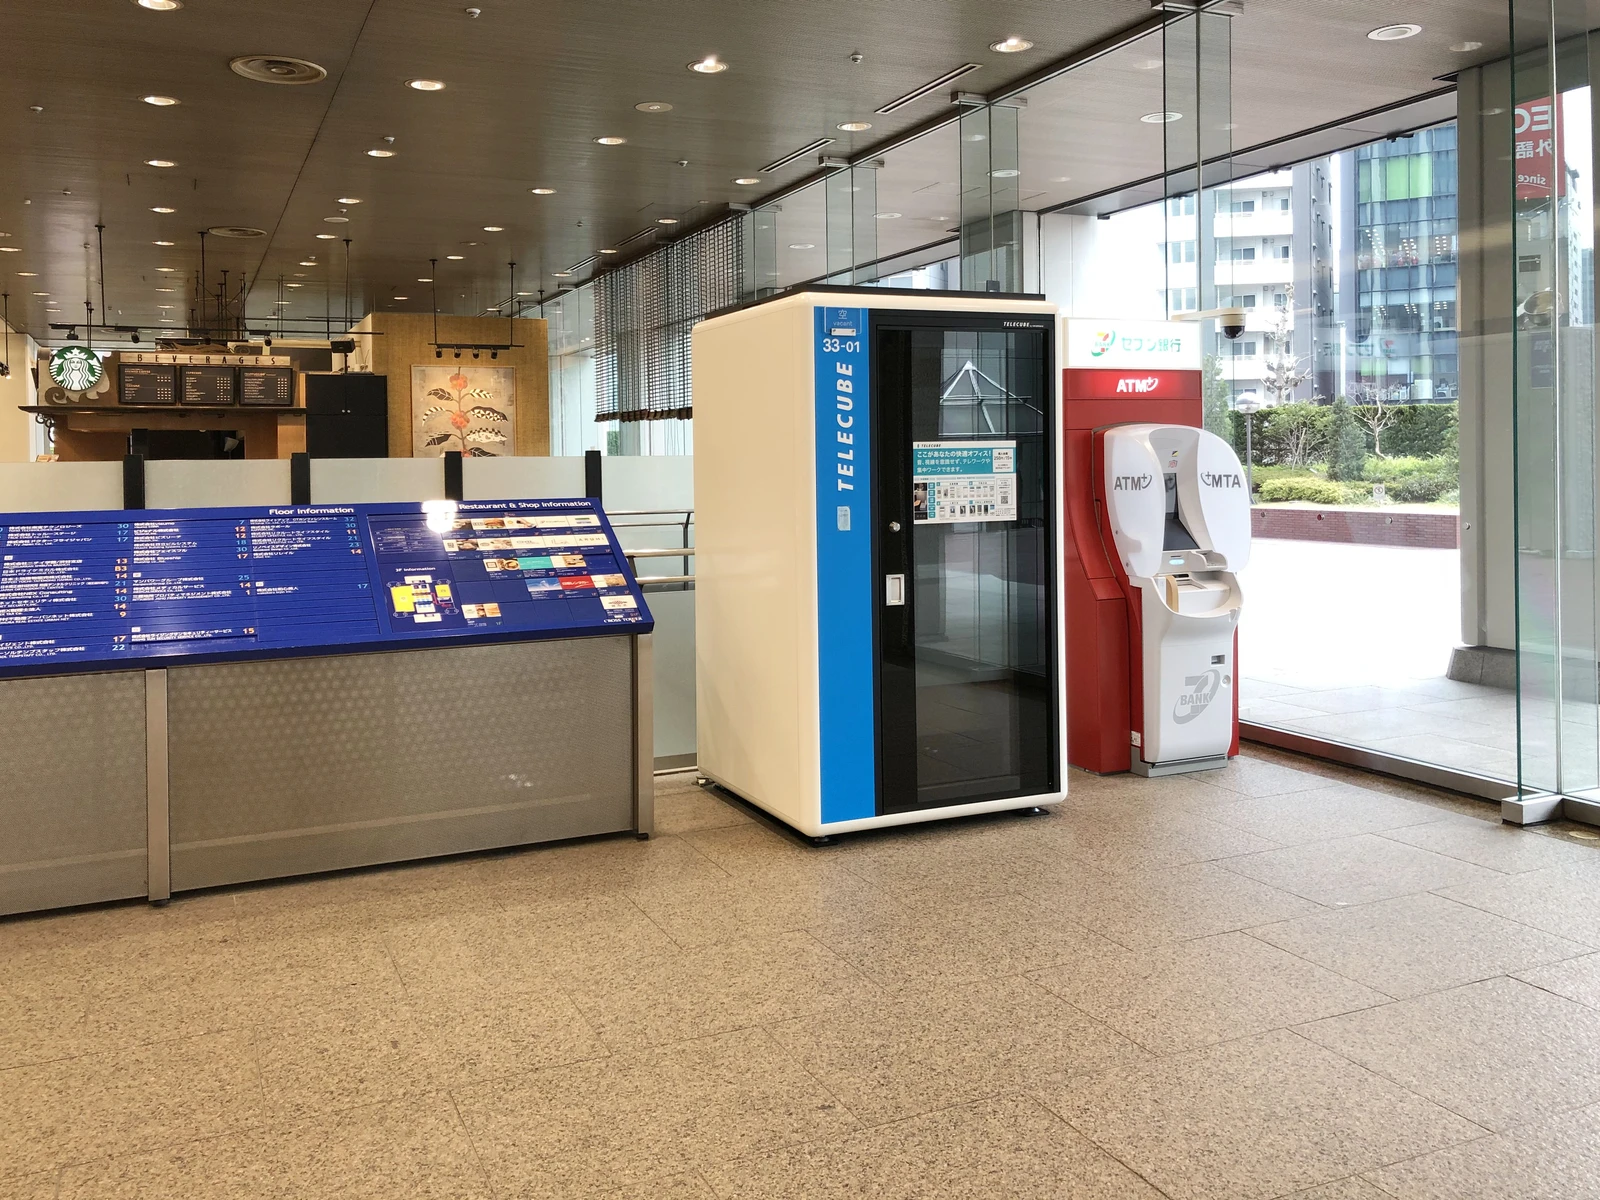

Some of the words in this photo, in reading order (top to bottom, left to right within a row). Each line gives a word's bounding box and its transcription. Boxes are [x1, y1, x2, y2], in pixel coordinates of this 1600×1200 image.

[837, 309, 848, 320] 空
[822, 338, 860, 353] 33-01
[137, 354, 276, 365] BEVERAGES
[836, 361, 854, 492] TELECUBE
[519, 501, 540, 509] Shop
[541, 500, 592, 508] Information
[297, 507, 354, 515] Information
[1180, 692, 1211, 706] BANK
